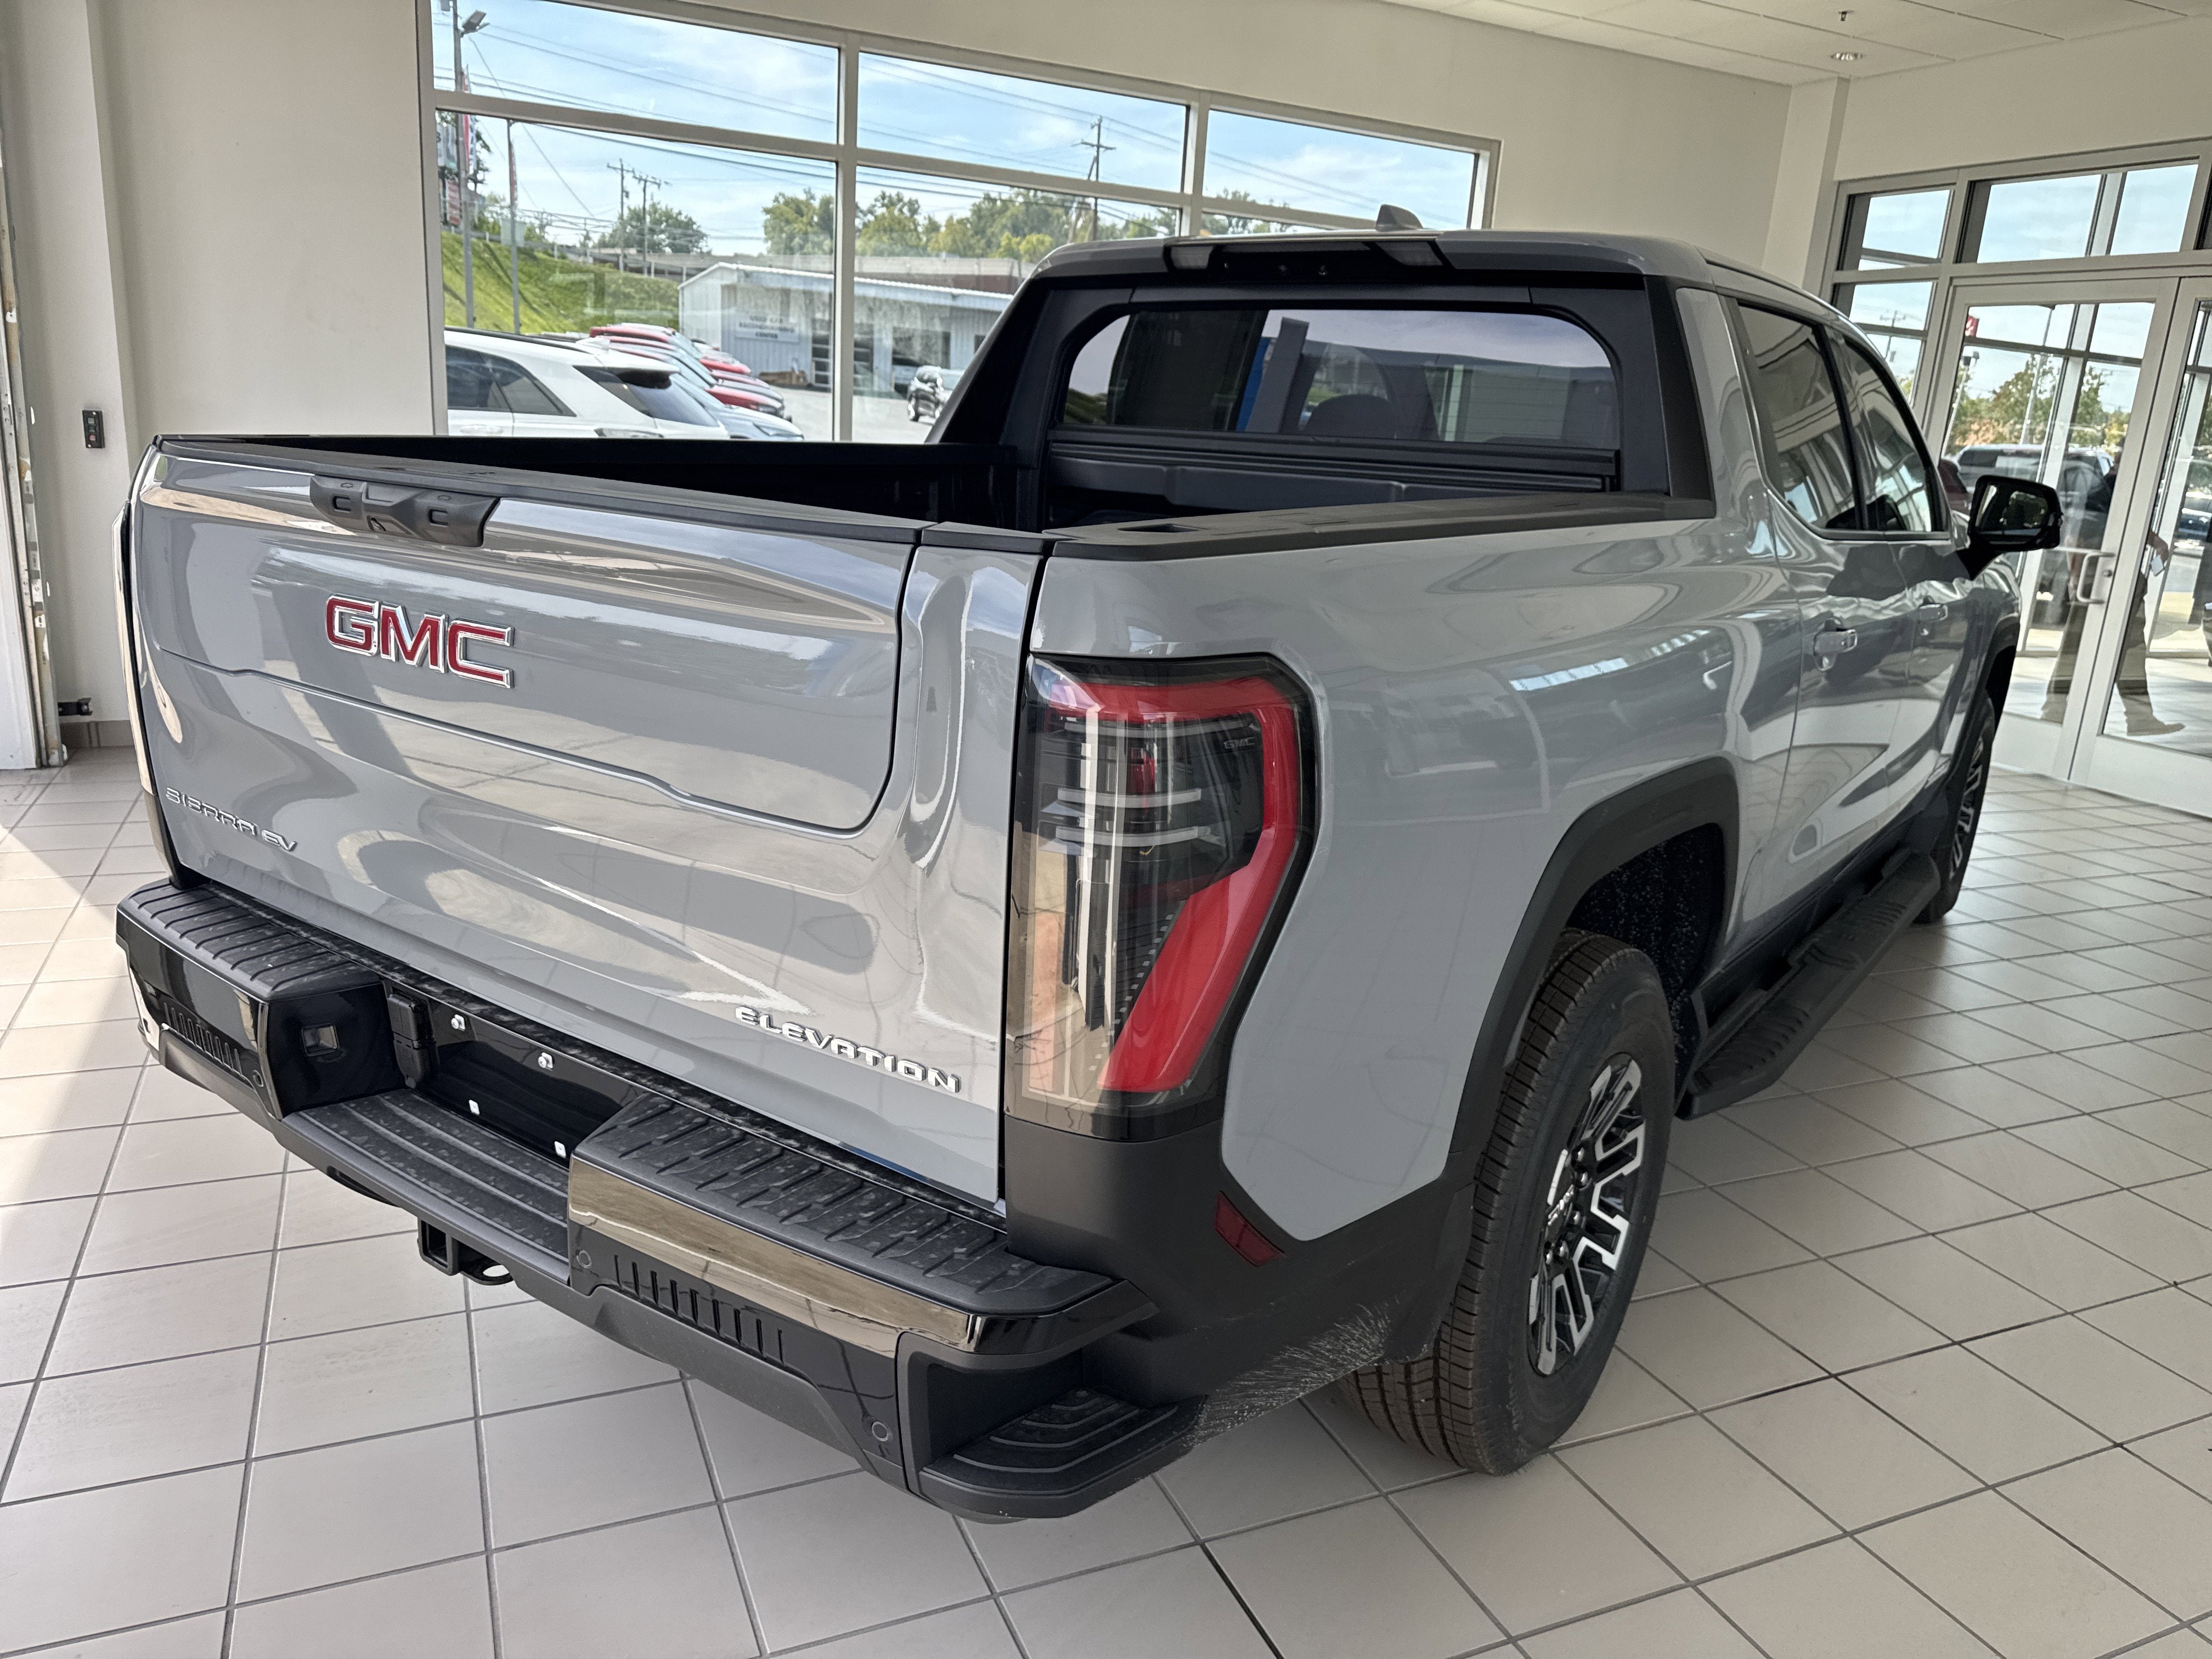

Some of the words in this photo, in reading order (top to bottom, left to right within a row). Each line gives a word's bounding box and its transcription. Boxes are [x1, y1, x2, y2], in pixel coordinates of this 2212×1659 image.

[325, 593, 515, 689] GMC
[1223, 737, 1255, 749] GMC
[166, 787, 258, 836] SIERRA
[261, 829, 298, 852] EV
[735, 1006, 962, 1093] ELEVATION
